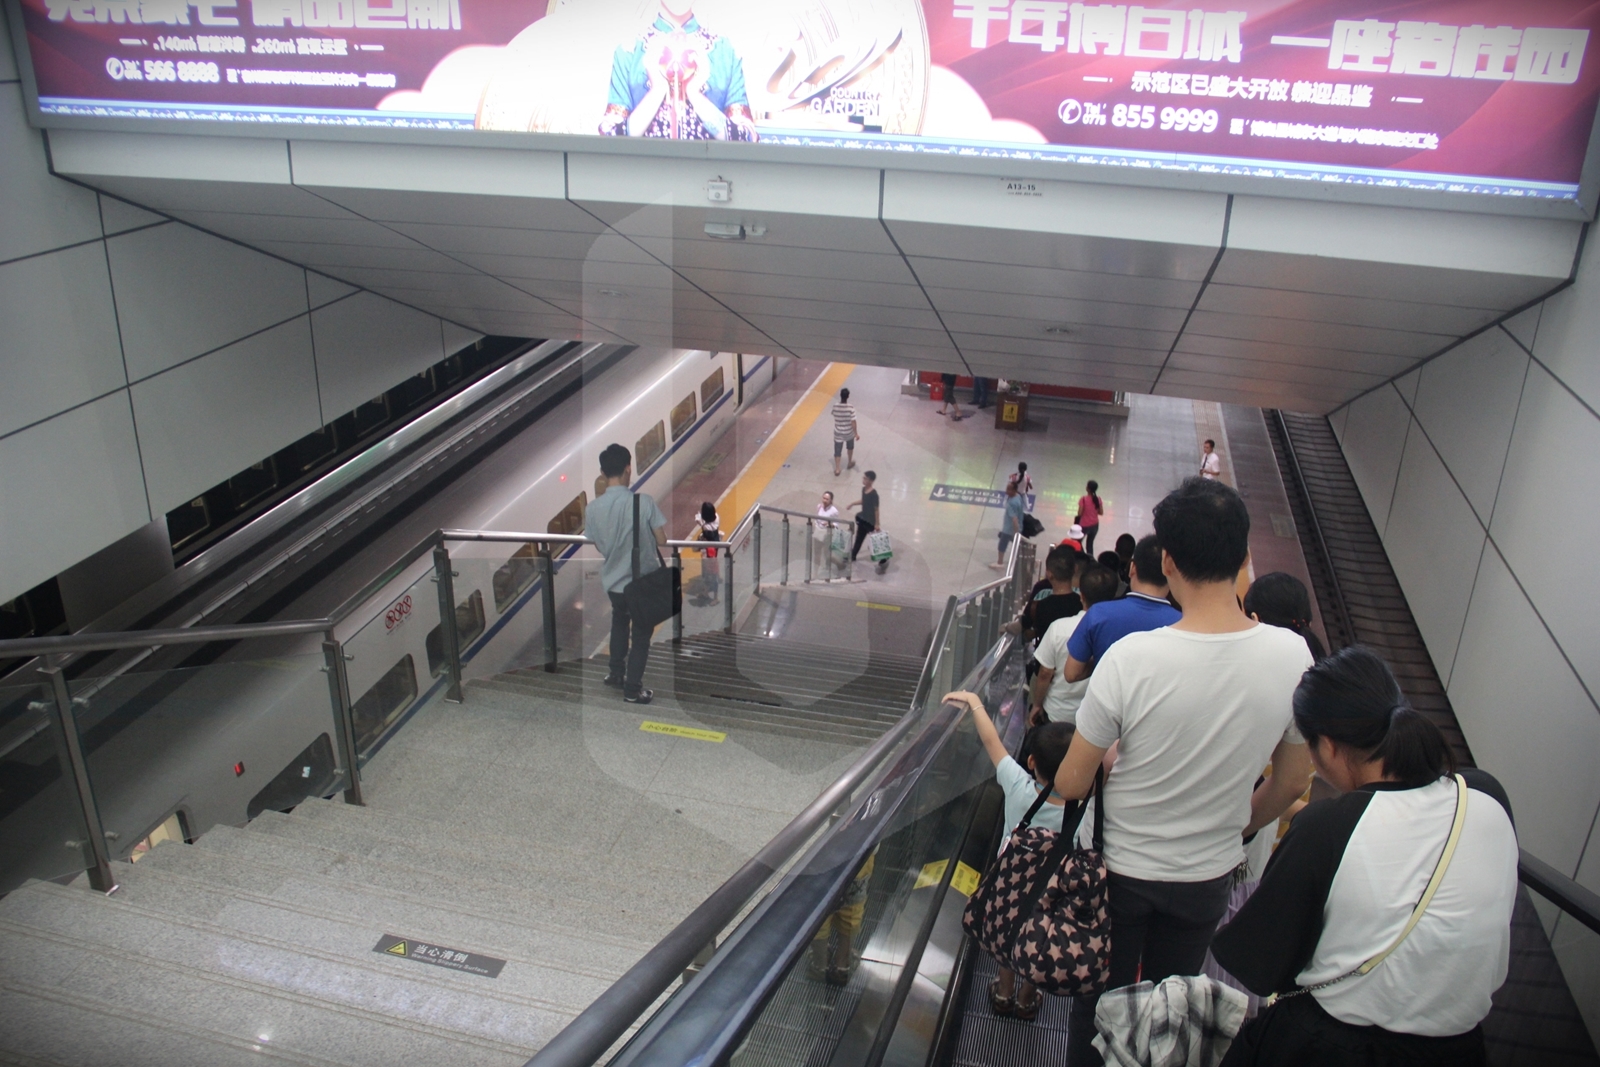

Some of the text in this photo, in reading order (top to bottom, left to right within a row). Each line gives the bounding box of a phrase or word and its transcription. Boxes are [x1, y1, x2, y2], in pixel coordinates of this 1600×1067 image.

[144, 60, 177, 81] 566
[177, 61, 220, 83] 8888
[830, 86, 881, 101] COUNTRY
[1131, 71, 1289, 102] 示范区已盛大开放
[811, 96, 881, 118] GARDEN
[1112, 103, 1155, 128] 855
[1160, 106, 1220, 133] 9999
[1006, 182, 1036, 191] A13-15
[414, 944, 469, 963] 当心滑倒
